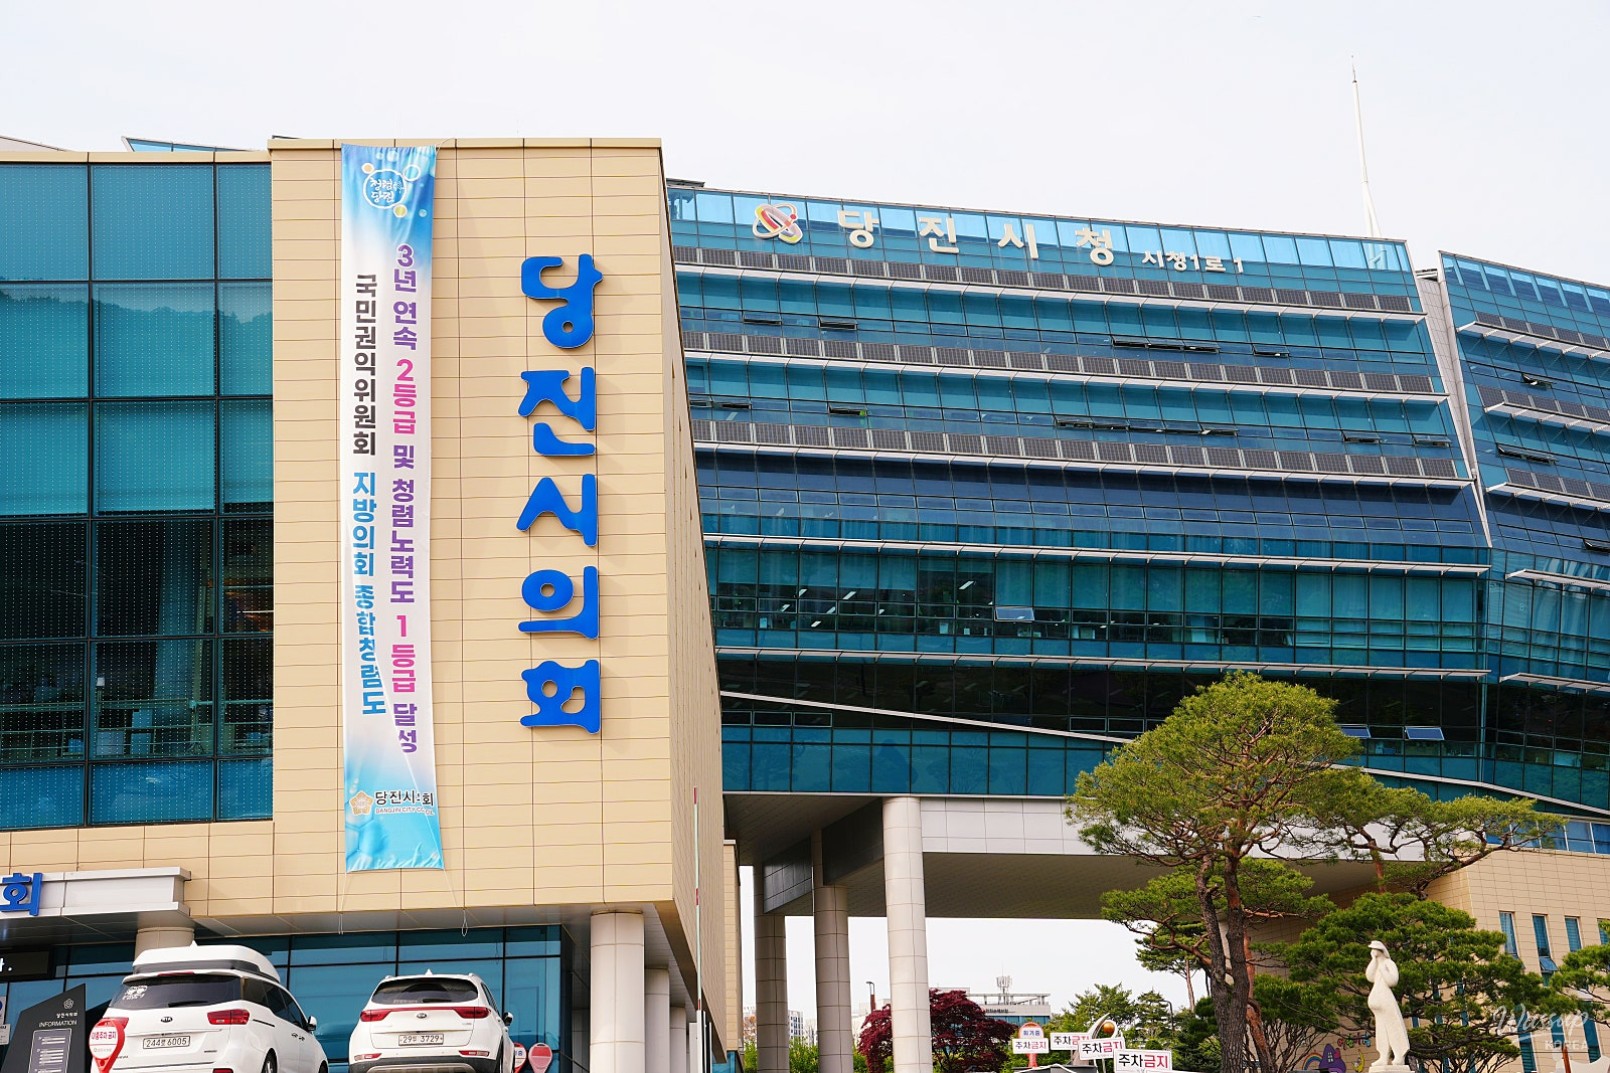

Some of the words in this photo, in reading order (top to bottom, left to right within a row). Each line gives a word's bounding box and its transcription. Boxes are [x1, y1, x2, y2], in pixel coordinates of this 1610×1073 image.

[837, 210, 1115, 266] 당진시청
[393, 244, 417, 293] 3년
[393, 301, 418, 351] 연속
[353, 274, 377, 456] 국민권익위원회
[393, 358, 417, 434] 2등급
[393, 445, 415, 469] 및
[516, 253, 603, 735] 당진시의회
[352, 472, 377, 577] 지방의회
[390, 478, 415, 603] 청렴노력도
[354, 584, 387, 715] 종합청렴도
[393, 703, 418, 753] 달성
[375, 789, 434, 806] 당진시회
[0, 872, 43, 917] 회
[38, 1020, 78, 1028] INFORMATION
[1015, 1041, 1047, 1050] 주차금지
[1081, 1040, 1123, 1054] 주차금지
[1118, 1053, 1169, 1068] 주차금지
